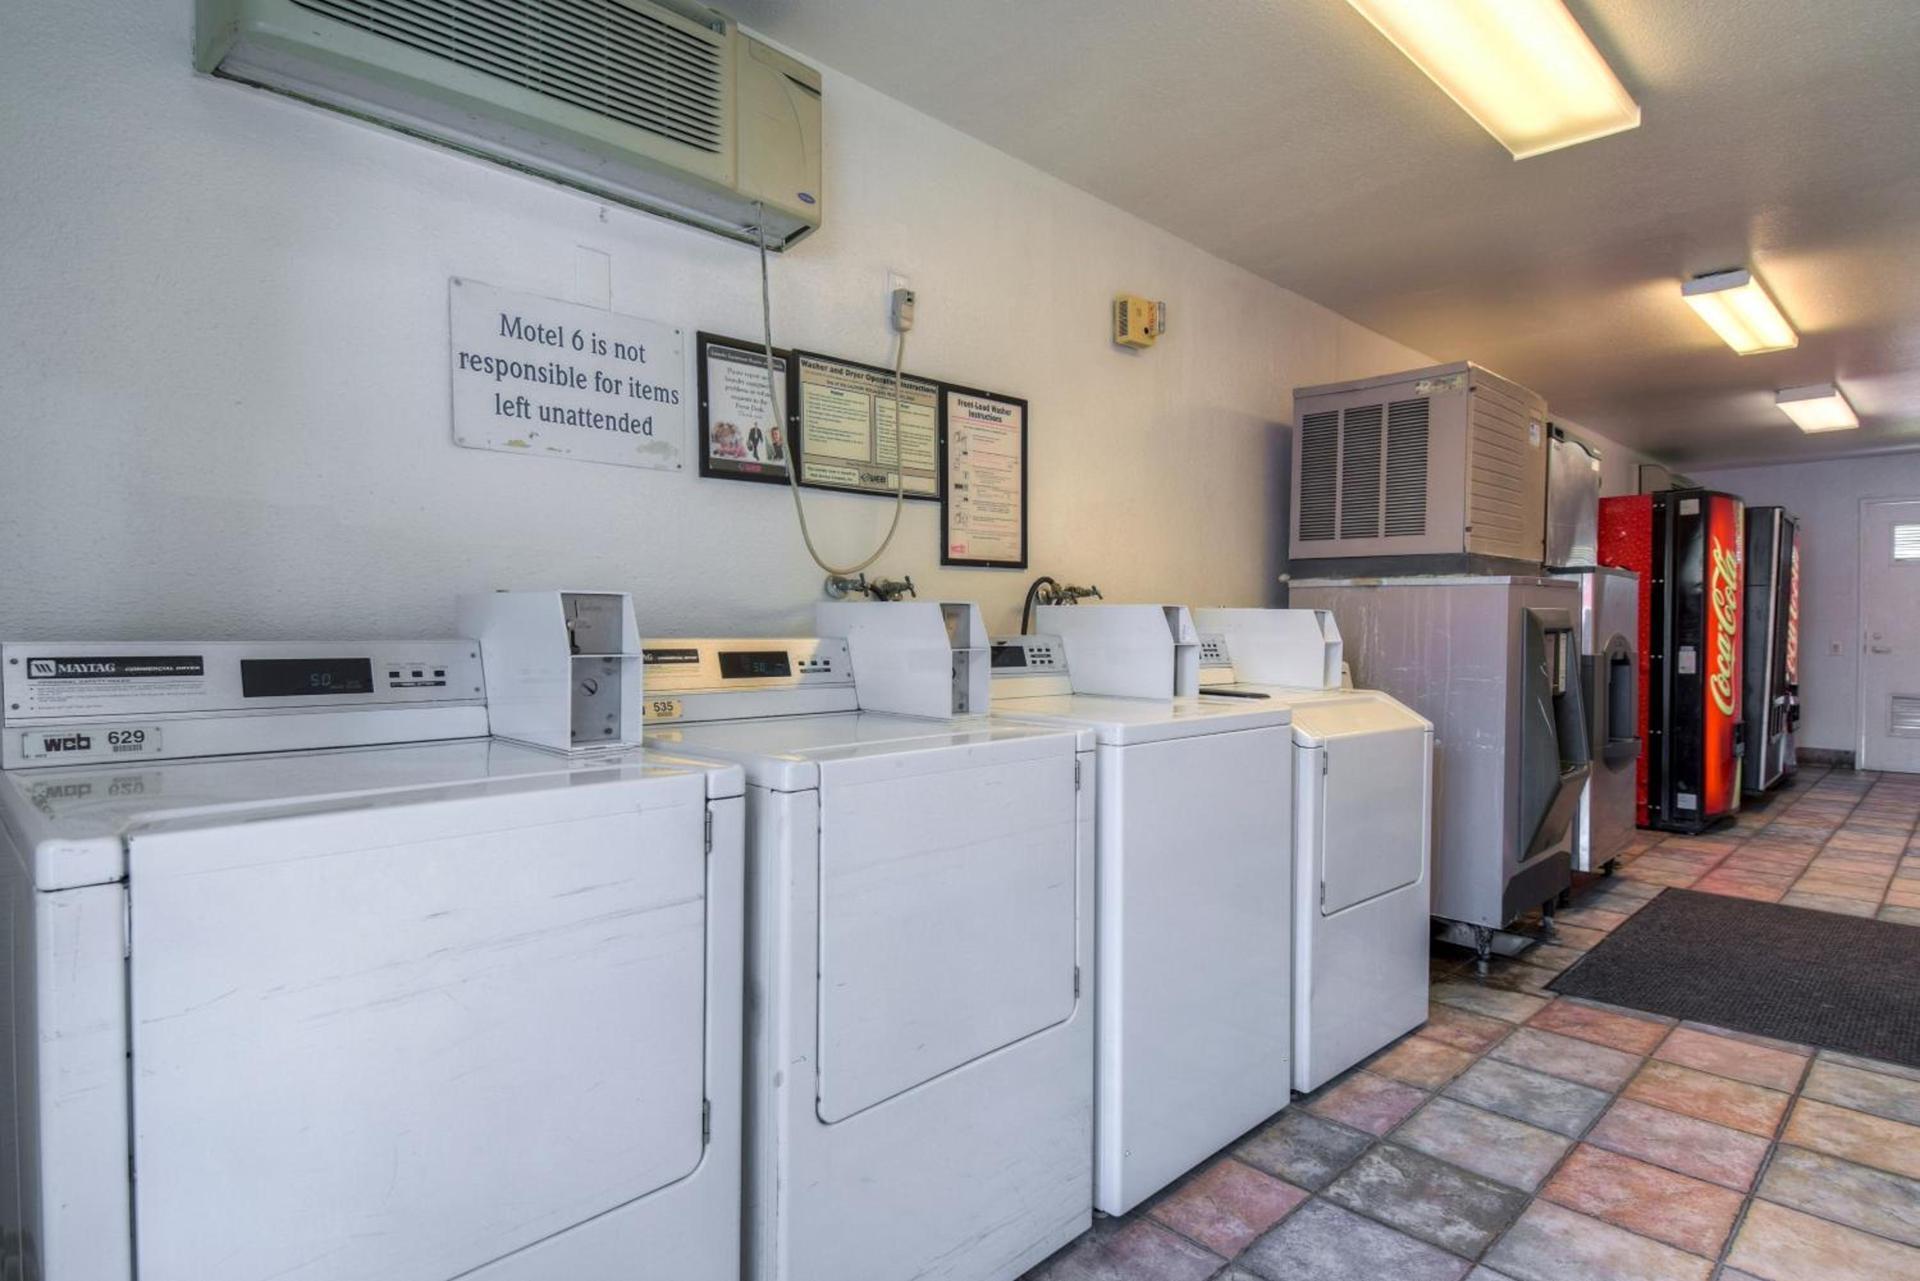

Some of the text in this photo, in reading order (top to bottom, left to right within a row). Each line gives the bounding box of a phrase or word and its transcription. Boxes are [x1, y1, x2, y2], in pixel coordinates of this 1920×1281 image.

[500, 313, 647, 364] Motel 6 is not
[458, 350, 680, 405] responsible for items
[800, 358, 829, 373] Washer
[829, 364, 844, 375] and
[845, 368, 865, 381] Dryer
[495, 392, 653, 437] left unattended
[58, 663, 116, 673] MAYTAG
[653, 700, 674, 713] 535
[44, 733, 91, 752] wcb
[107, 729, 145, 745] 629
